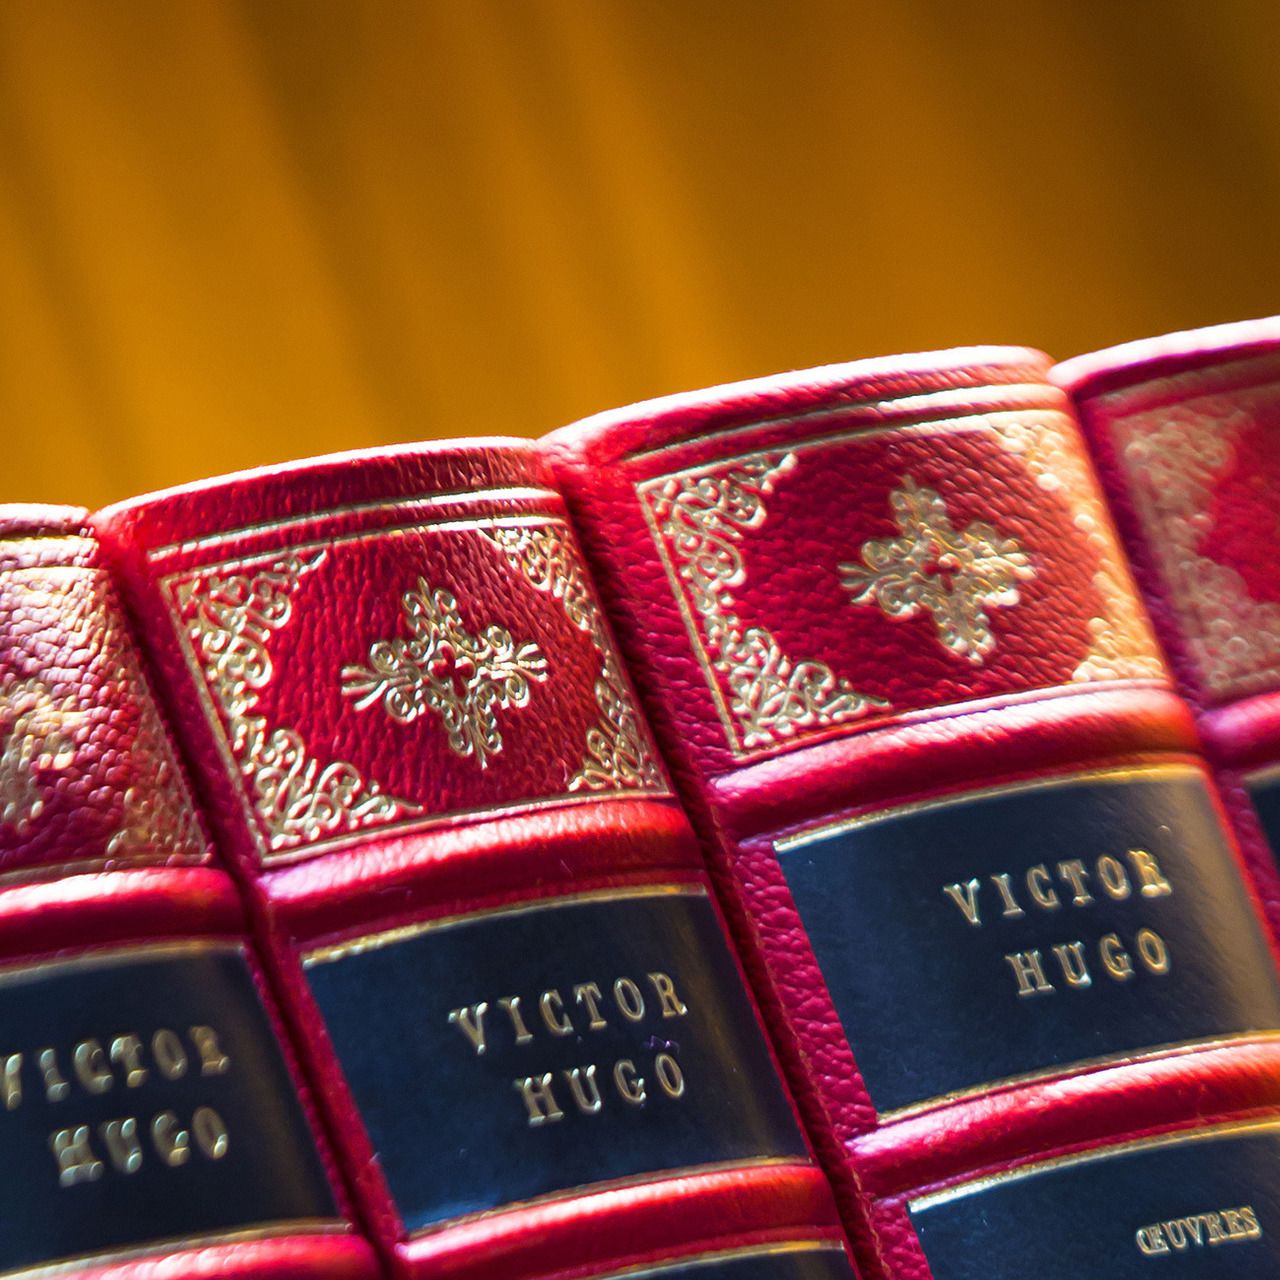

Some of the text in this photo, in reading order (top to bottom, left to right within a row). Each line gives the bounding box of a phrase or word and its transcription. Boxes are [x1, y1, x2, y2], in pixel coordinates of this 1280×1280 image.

[943, 848, 1172, 926] VICTOR
[1004, 927, 1170, 998] HUGO
[448, 972, 688, 1055] VICTOR
[514, 1053, 686, 1128] HUGO
[50, 1106, 229, 1188] HUGO
[1136, 1206, 1262, 1256] ŒUVRES
